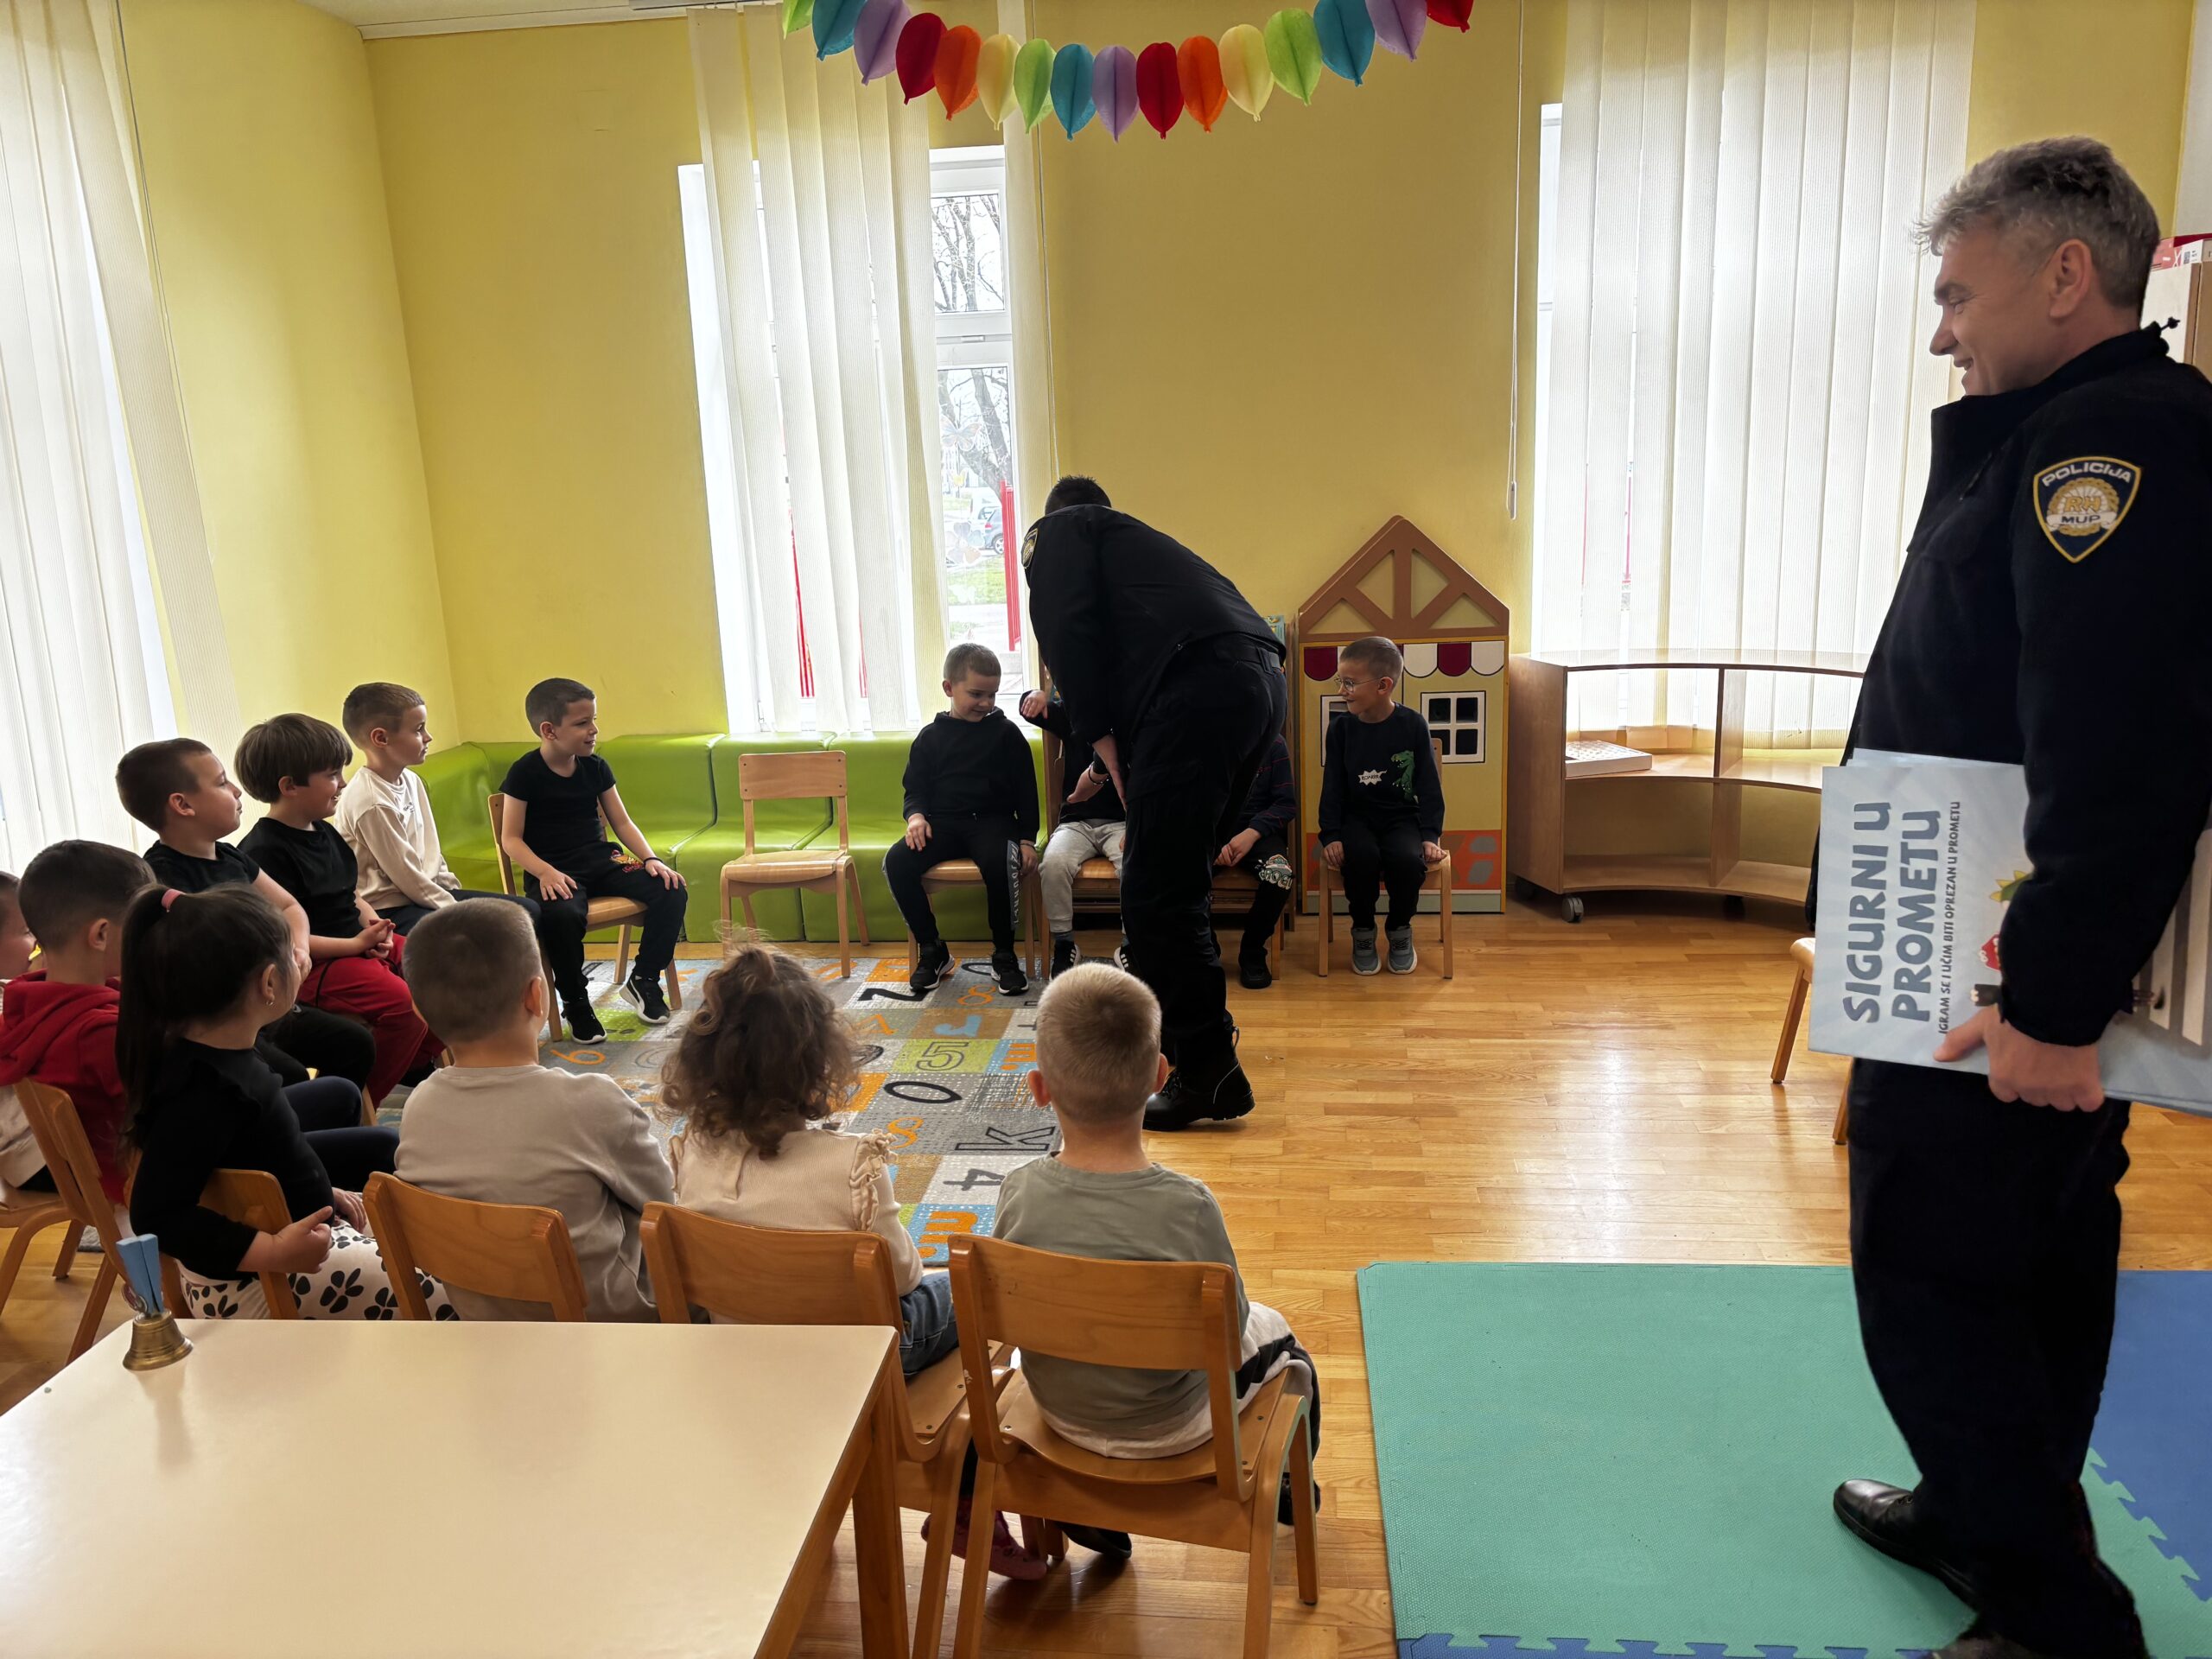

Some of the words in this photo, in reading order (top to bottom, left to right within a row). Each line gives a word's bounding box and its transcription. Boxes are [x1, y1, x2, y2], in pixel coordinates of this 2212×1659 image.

[2042, 462, 2132, 486] POLICIJA
[2064, 495, 2101, 512] RH
[2061, 515, 2101, 524] MUP
[1853, 802, 1891, 830] U
[1948, 802, 1961, 854] PROMETU
[1944, 867, 1957, 919] OPREZAN
[1891, 810, 1941, 1022] PROMETU
[1842, 844, 1889, 1023] SIGURNI
[1943, 922, 1954, 942] BITI
[1939, 945, 1952, 973] UČIM
[1941, 981, 1951, 994] SE
[1938, 997, 1949, 1034] IGRAM
[916, 1041, 969, 1071] 5
[955, 1126, 1055, 1151] K
